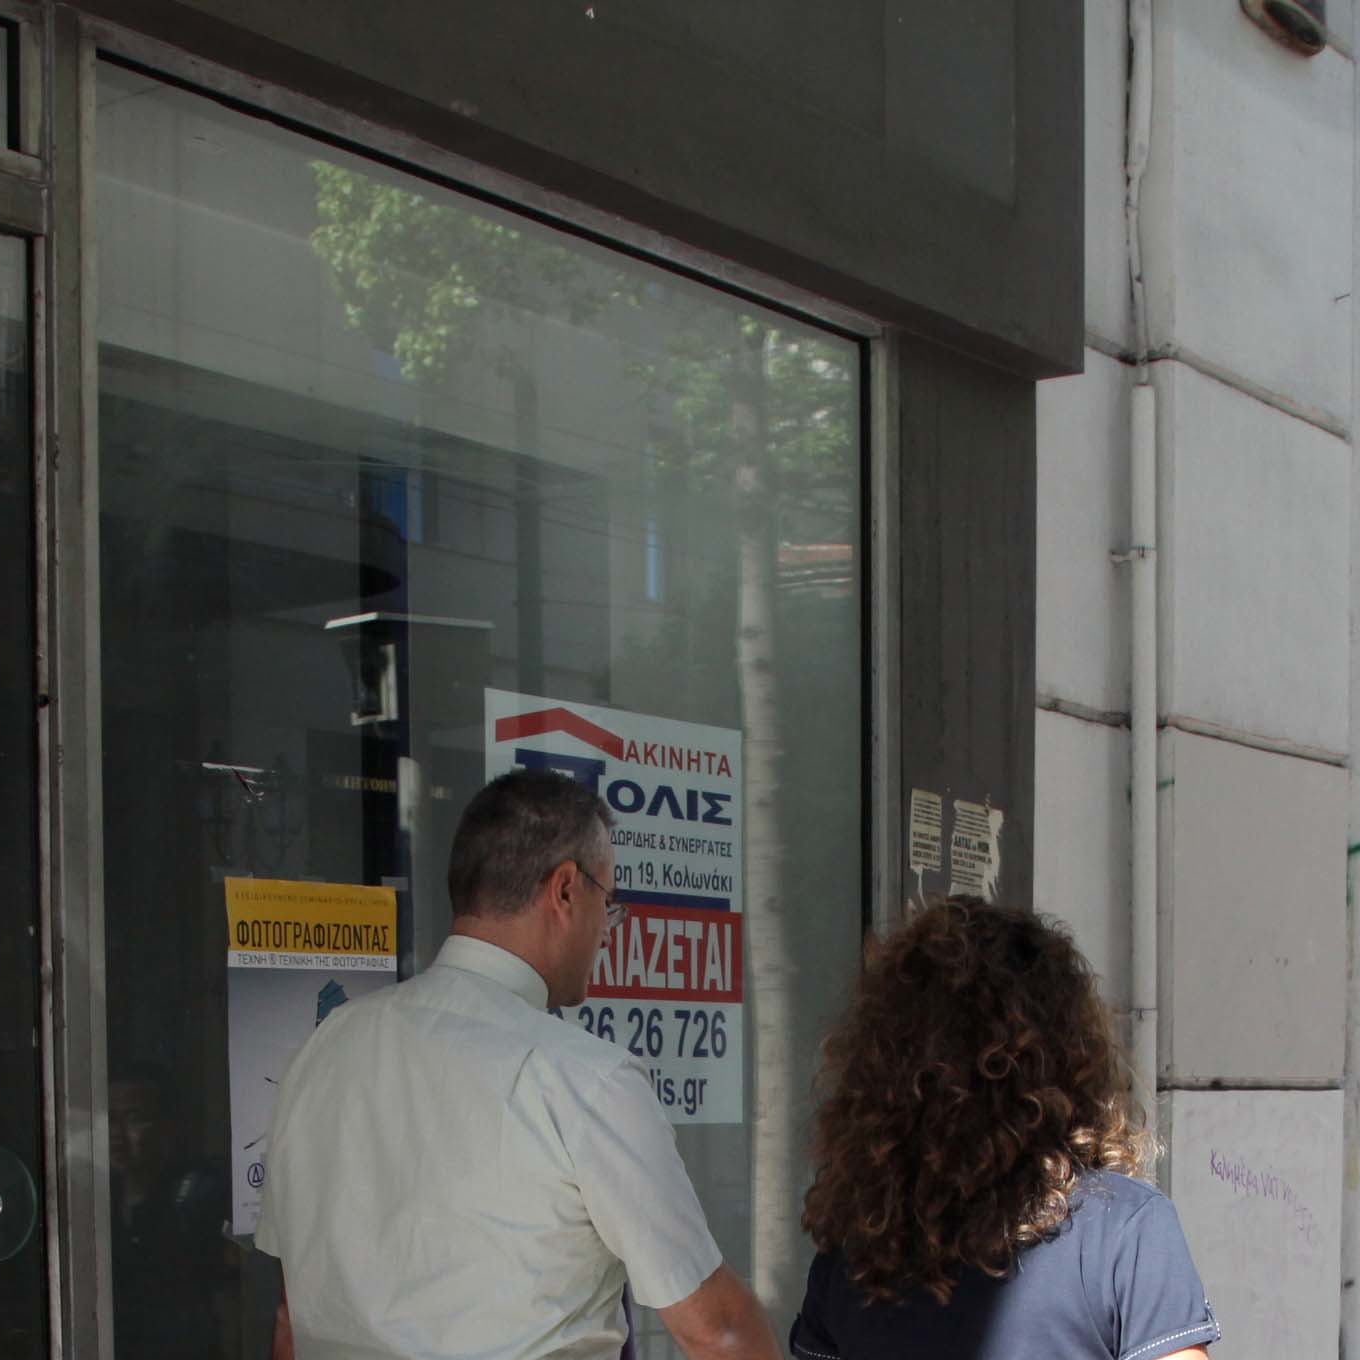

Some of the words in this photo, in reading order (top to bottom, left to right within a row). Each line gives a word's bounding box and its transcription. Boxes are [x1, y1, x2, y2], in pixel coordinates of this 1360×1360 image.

[624, 741, 733, 779] ΑΚΙΝΗΤΑ
[610, 829, 657, 851] ΔΩΡΙΔΗΣ
[668, 835, 733, 859] ΣΥΝΕΡΓΑΤΕΣ
[637, 862, 659, 890] 19,
[662, 865, 733, 894] Κολωνάκι
[236, 920, 390, 952] ΦΩΤΟΓΡΑΦΙΖΟΝΤΑΣ
[238, 953, 267, 966] ΤΕΧΝΗ
[315, 956, 330, 968] ΤΗΣ
[593, 914, 733, 992] ΚΙΑΖΕΤΑΙ
[628, 1008, 664, 1058] 26
[675, 1010, 727, 1059] 726
